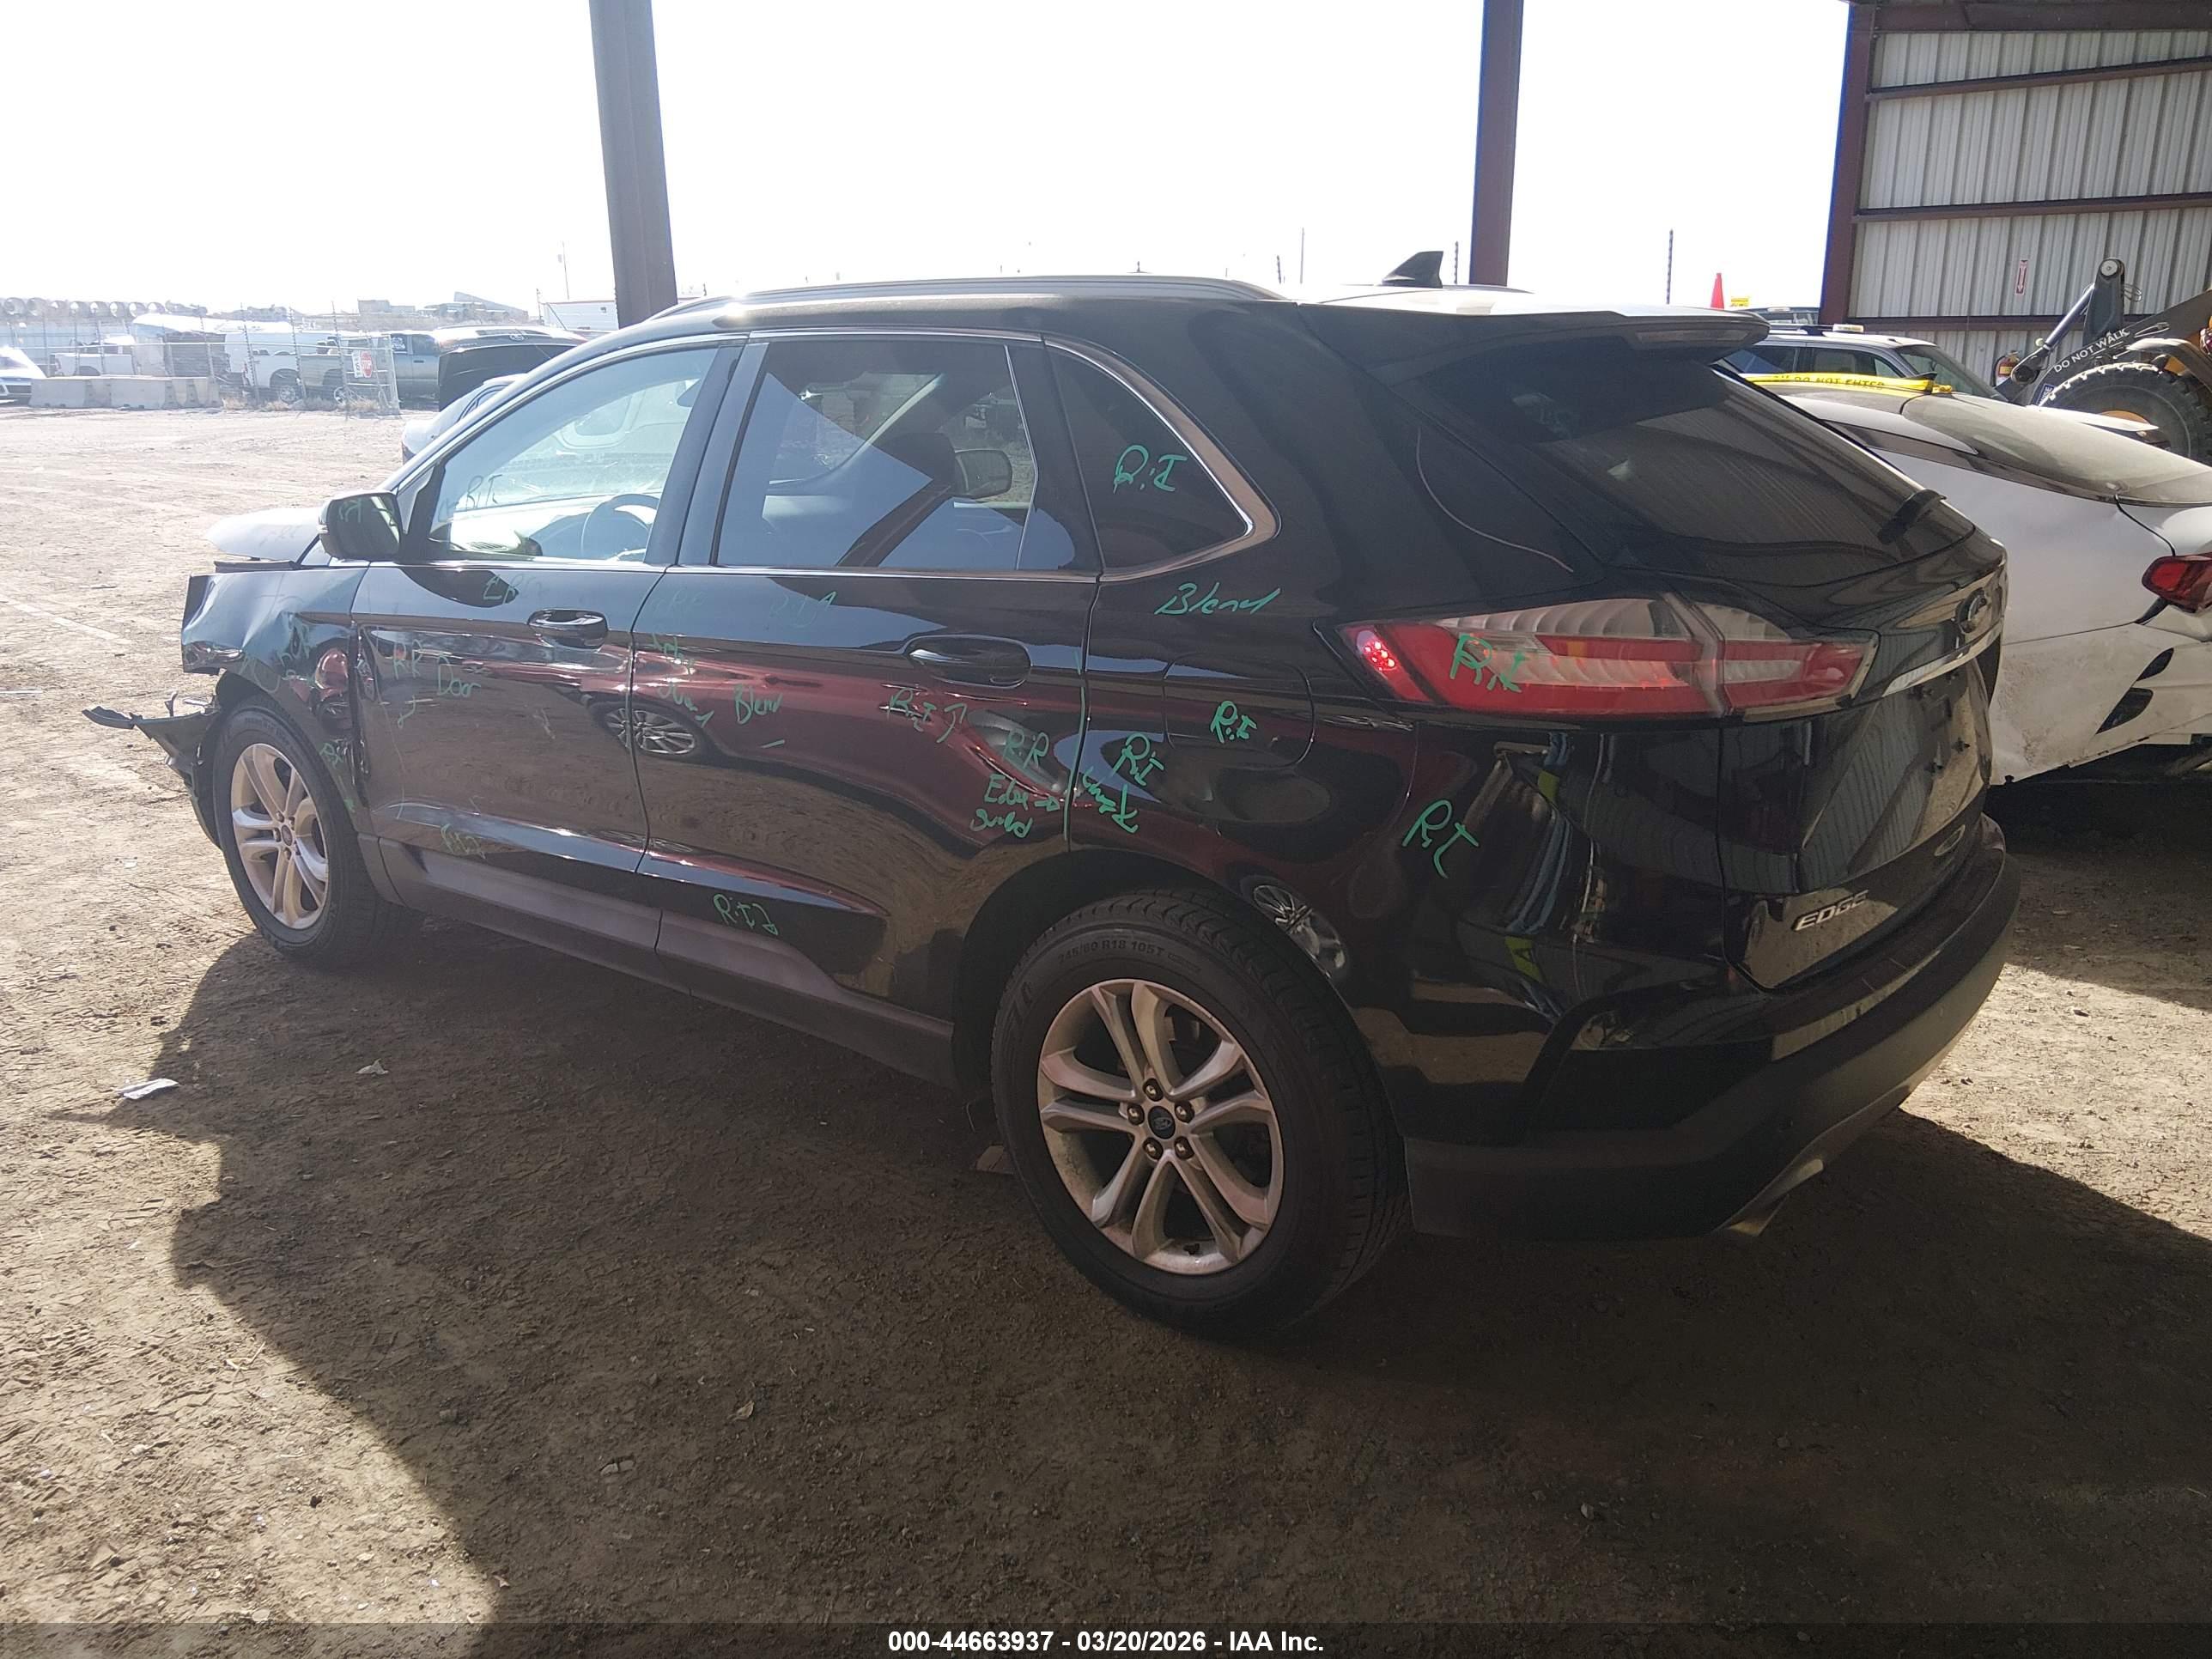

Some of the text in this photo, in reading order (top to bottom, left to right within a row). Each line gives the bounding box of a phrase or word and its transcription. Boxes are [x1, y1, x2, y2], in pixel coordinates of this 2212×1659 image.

[2054, 328, 2130, 373] DO NOT WALK
[1154, 581, 1280, 615] Blend
[1795, 890, 1869, 931] EDGE
